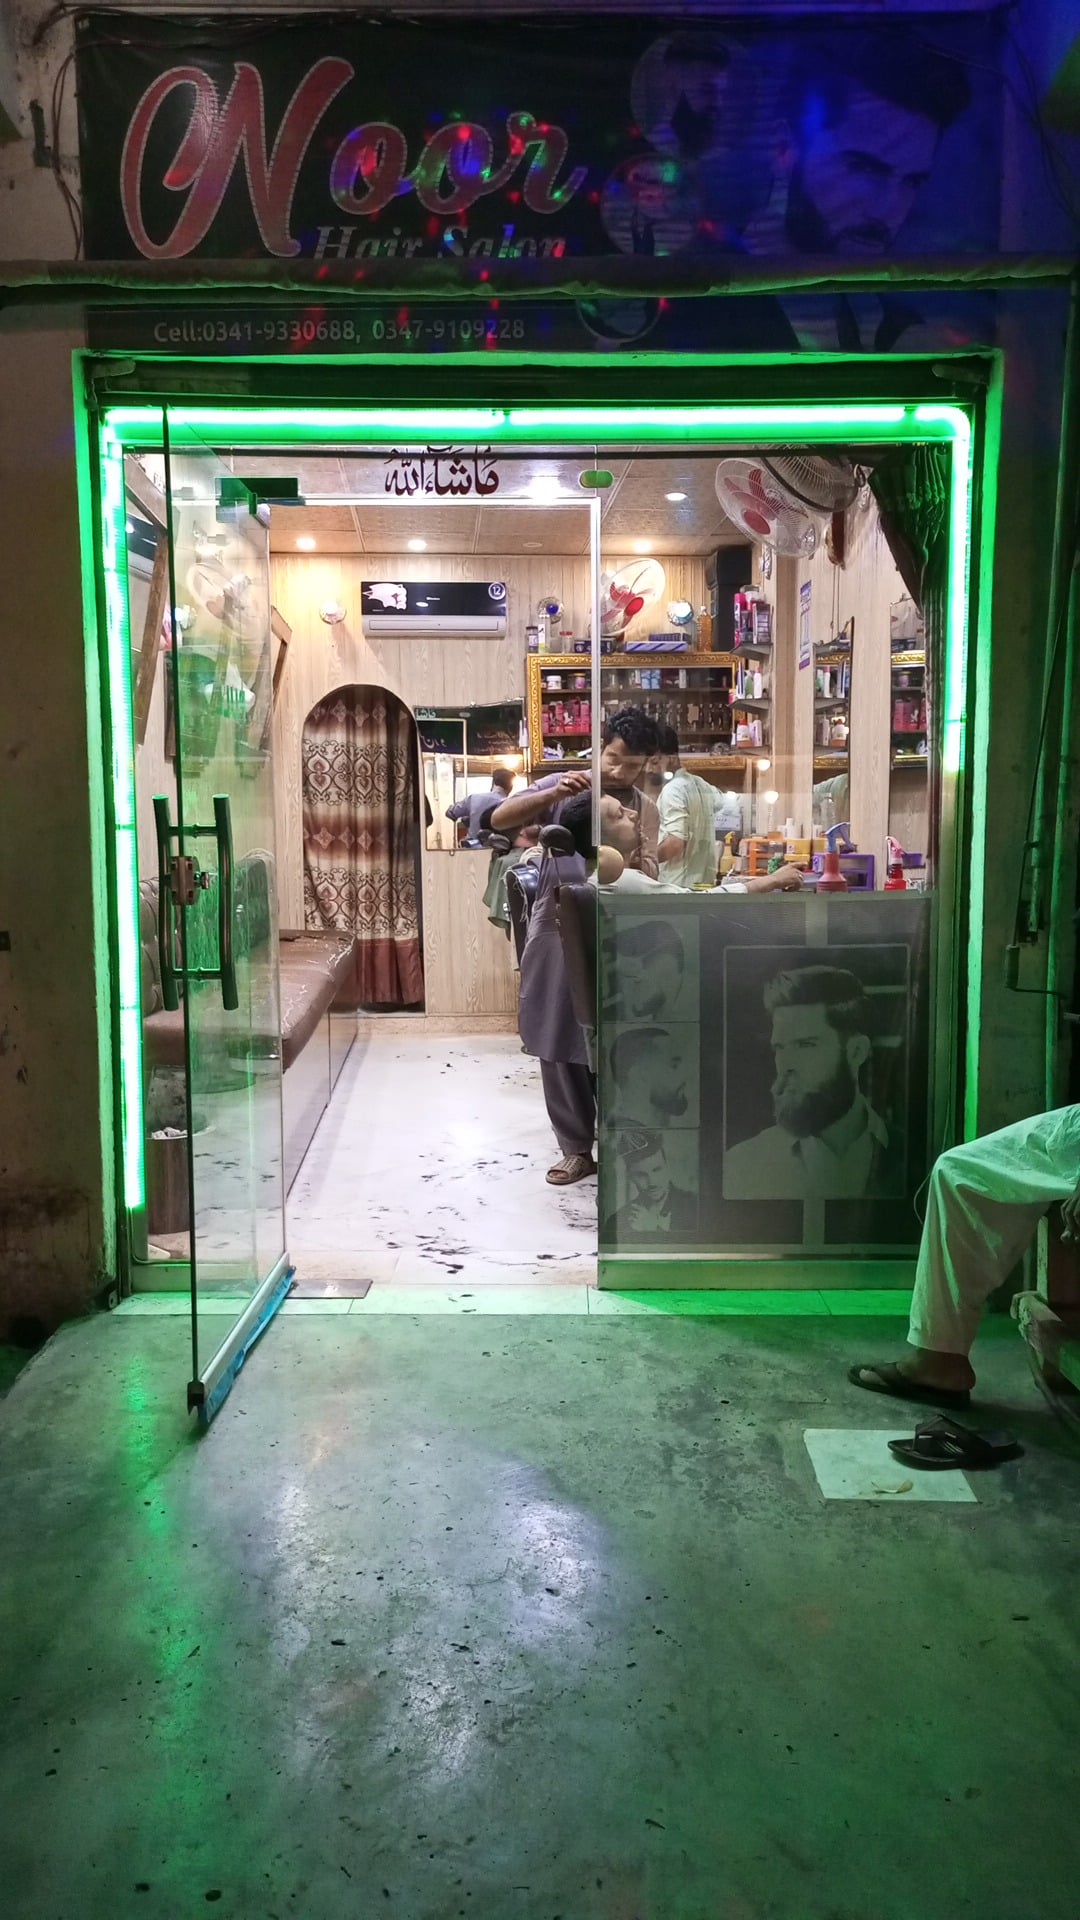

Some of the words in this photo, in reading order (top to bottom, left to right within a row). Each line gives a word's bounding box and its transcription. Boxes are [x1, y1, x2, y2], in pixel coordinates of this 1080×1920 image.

[120, 56, 588, 260] Noor
[313, 225, 424, 259] Hair
[437, 223, 567, 259] Salon
[372, 318, 526, 341] 0347-9109228
